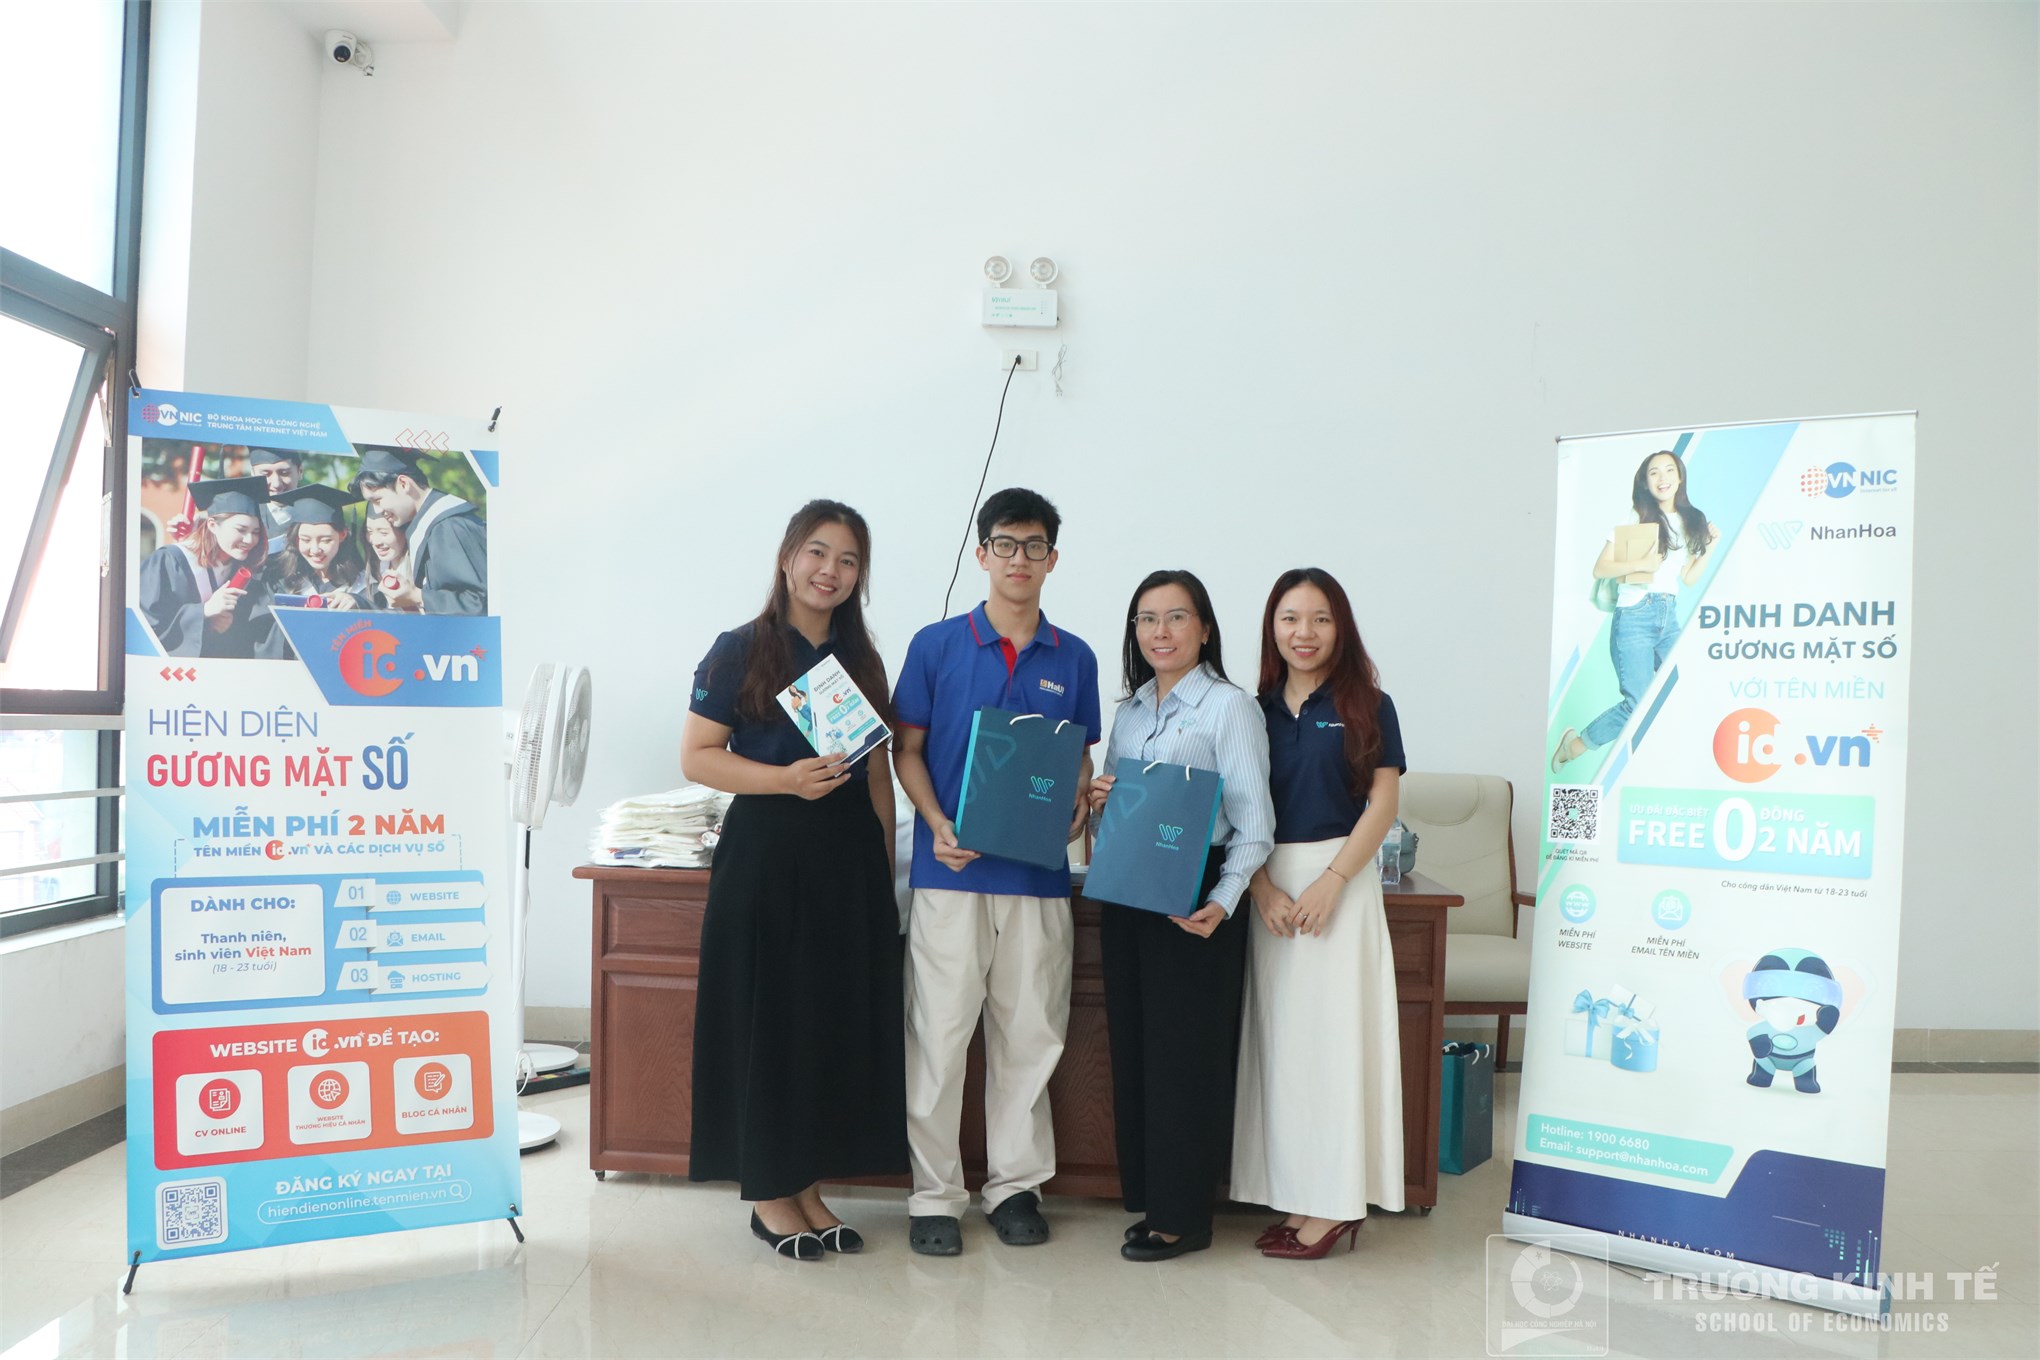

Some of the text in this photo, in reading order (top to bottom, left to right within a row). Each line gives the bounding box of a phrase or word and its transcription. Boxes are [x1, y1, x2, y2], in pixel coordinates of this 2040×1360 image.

[207, 413, 320, 430] BỘ KHOA HỌC VÀ CÔNG NGHỆ
[207, 421, 234, 430] TRUNG
[235, 422, 252, 431] TÂM
[253, 425, 290, 434] INTERNET
[292, 428, 309, 437] VIỆT
[310, 430, 328, 438] NAM
[1811, 523, 1897, 541] NhanHoa
[1698, 601, 1895, 636] ĐỊNH DANH
[1707, 633, 1898, 664] GƯƠNG MẶT SỐ
[1729, 674, 1885, 700] VỚI TÊN MIỀN
[149, 703, 319, 743] HIỆN DIỆN
[147, 732, 416, 797] GƯƠNG MẶT SỐ
[193, 805, 445, 838] MIỄN PHÍ 2 NĂM
[1712, 796, 1757, 863] 0
[1628, 819, 1706, 849] FREE
[1757, 820, 1862, 857] 2 NĂM
[193, 844, 224, 858] TÊN
[314, 842, 333, 855] VÀ
[340, 841, 365, 855] CÁC
[368, 842, 401, 857] DỊCH
[405, 842, 424, 856] VỤ
[427, 839, 446, 853] SỐ
[348, 885, 460, 901] 01 WEBSITE
[1721, 880, 1737, 889] Cho
[1738, 880, 1757, 892] công
[1759, 881, 1775, 891] dân
[1776, 882, 1792, 893] Việt
[1793, 884, 1813, 894] Nam
[1825, 887, 1849, 897] 18-23
[190, 896, 296, 913] DÀNH CHO:
[201, 930, 287, 944] Thanh niên,
[349, 927, 446, 942] 02 EMAIL
[1582, 929, 1596, 939] PHÍ
[1672, 938, 1687, 947] PHÍ
[175, 946, 312, 961] sinh viên Việt Nam
[1558, 940, 1593, 951] WEBSITE
[1631, 945, 1657, 956] EMAIL
[1658, 946, 1676, 957] TÊN
[212, 964, 228, 975] (18
[236, 962, 250, 972] 23
[350, 968, 461, 983] 03 HOSTING
[210, 1038, 298, 1058] WEBSITE
[367, 1027, 393, 1047] ĐỂ
[397, 1029, 440, 1048] TẠO:
[401, 1105, 468, 1119] BLOG CÁ NHÂN
[195, 1126, 247, 1138] CV ONLINE
[1541, 1122, 1650, 1151] Hotline: 1900 6680
[1539, 1137, 1709, 1177] Email: support@nhanhoa.com
[275, 1162, 452, 1196] ĐĂNG KÝ NGAY TẠI
[268, 1187, 447, 1218] hiendienonline.tenmien.vn
